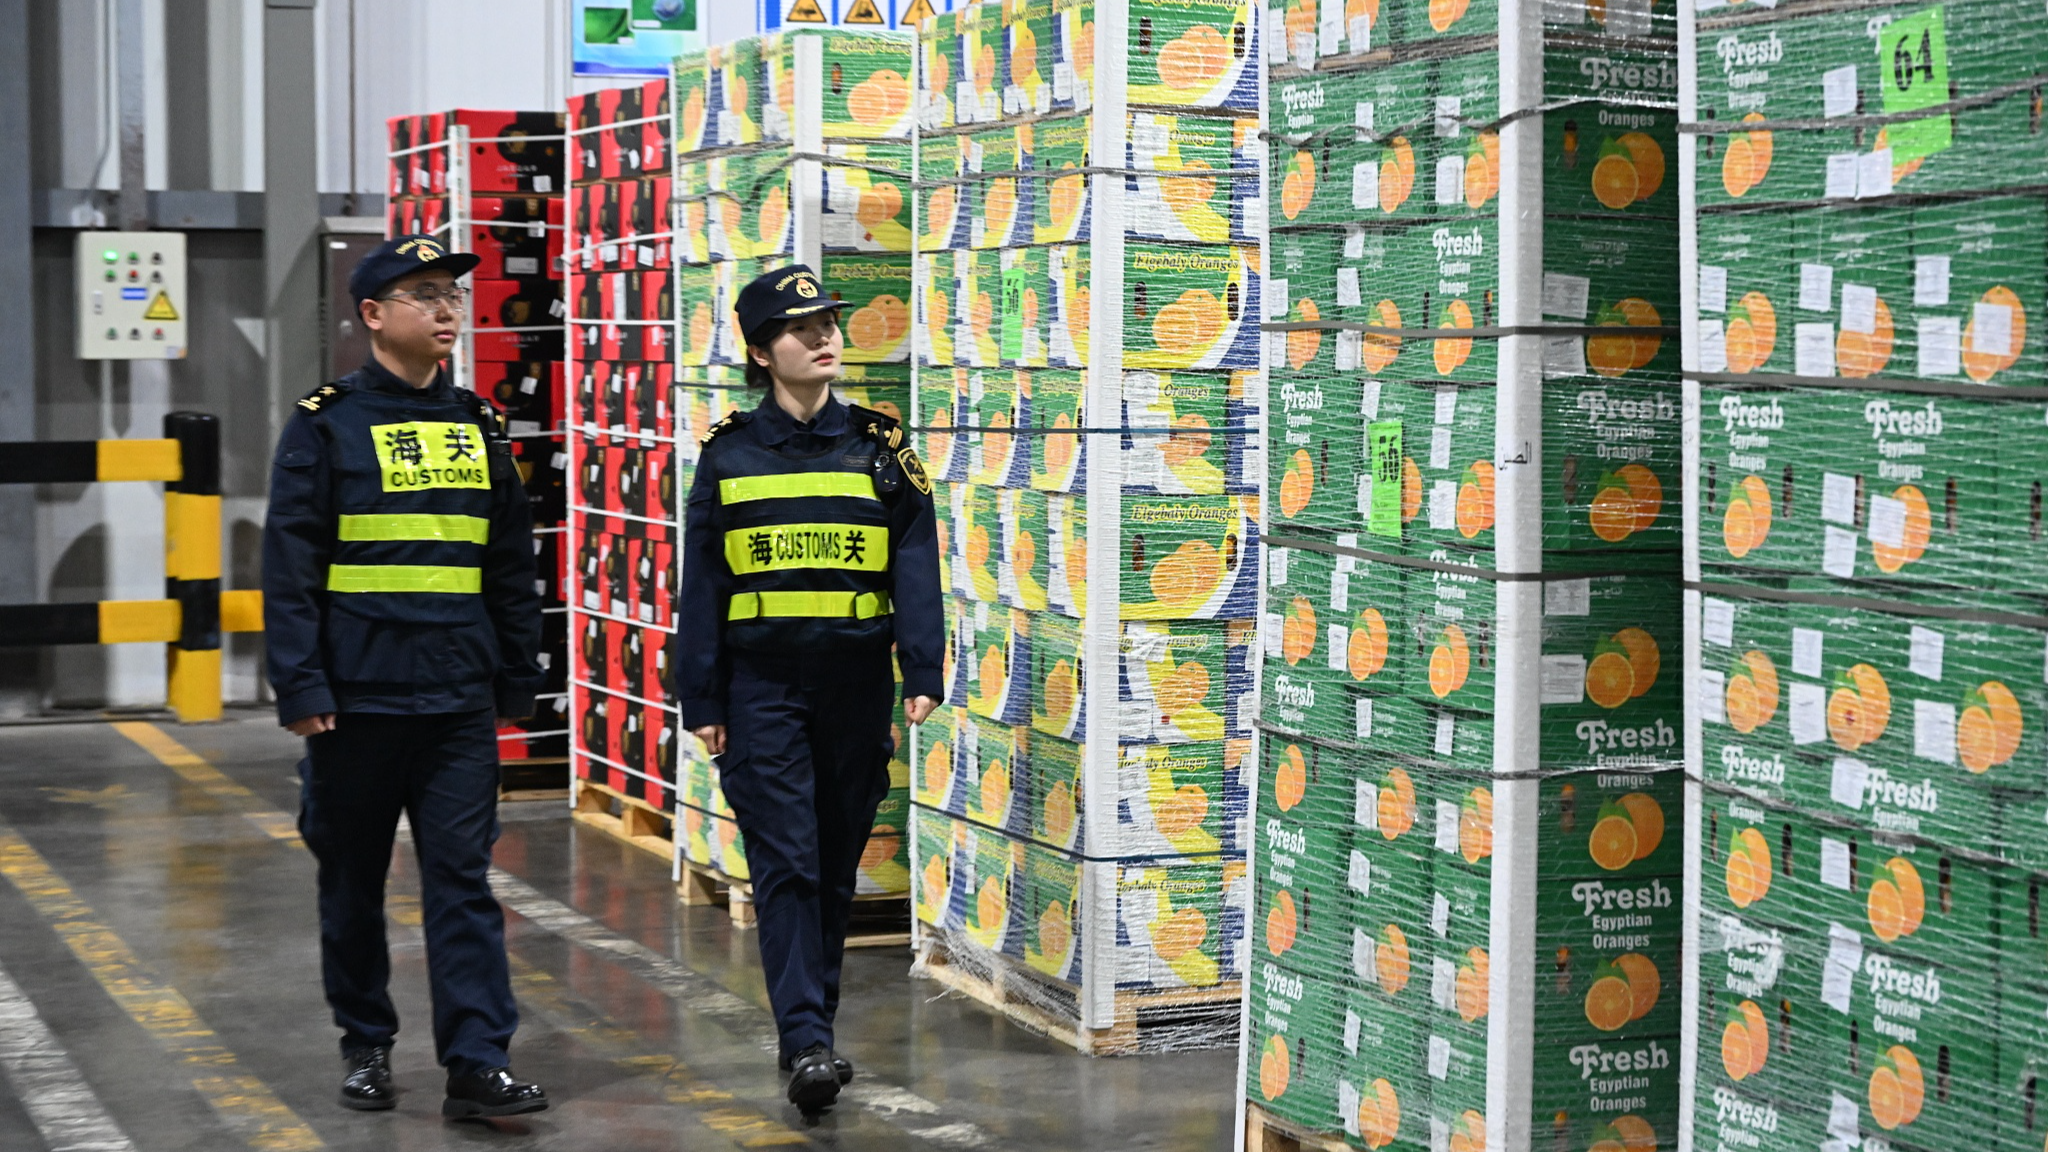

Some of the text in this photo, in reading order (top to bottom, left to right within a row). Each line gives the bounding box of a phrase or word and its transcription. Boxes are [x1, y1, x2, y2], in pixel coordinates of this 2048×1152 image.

[1717, 31, 1783, 73] Fresh
[1894, 28, 1934, 92] 64
[1580, 57, 1678, 90] Fresh
[1282, 81, 1325, 116] Fresh
[1599, 110, 1655, 129] Oranges
[1169, 130, 1215, 145] Oranges
[1432, 226, 1483, 262] Fresh
[1190, 254, 1239, 271] Oranges
[1439, 260, 1471, 277] Egyptian
[1439, 279, 1469, 297] Oranges
[1164, 384, 1209, 399] Oranges
[1281, 382, 1323, 413] Fresh
[1577, 391, 1675, 423] Fresh
[1719, 395, 1784, 432] Fresh
[1286, 413, 1313, 428] Egyptian
[1864, 400, 1942, 439] Fresh
[1286, 430, 1311, 446] Oranges
[1597, 423, 1655, 441] Egyptian
[1730, 431, 1769, 450] Egyptian
[386, 428, 477, 466] 海关
[1597, 444, 1654, 460] Oranges
[1878, 438, 1926, 458] Egyptian
[1728, 451, 1767, 473] Oranges
[1878, 460, 1923, 483] Oranges
[391, 468, 483, 487] CUSTOMS
[1189, 506, 1238, 522] Oranges
[748, 530, 865, 565] 海 CUSTOMS 关
[1275, 675, 1315, 707] Fresh
[1576, 718, 1676, 755] Fresh
[1162, 757, 1207, 770] Oranges
[1597, 752, 1656, 768] Egyptian
[1721, 745, 1785, 785] Fresh
[1597, 774, 1654, 789] Oranges
[1865, 768, 1938, 813] Fresh
[1729, 801, 1765, 825] Oranges
[1873, 806, 1919, 831] Egyptian
[1266, 819, 1306, 855] Fresh
[1271, 850, 1296, 869] Egyptian
[1270, 866, 1293, 887] Oranges
[1571, 879, 1672, 916] Fresh
[1592, 914, 1652, 931] Egyptian
[1592, 934, 1650, 950] Oranges
[1263, 962, 1304, 1002] Fresh
[1726, 972, 1763, 998] Oranges
[1865, 953, 1940, 1004] Fresh
[1267, 994, 1292, 1014] Egyptian
[1875, 993, 1921, 1020] Egyptian
[1265, 1010, 1288, 1033] Oranges
[1873, 1014, 1917, 1043] Oranges
[1569, 1041, 1670, 1080] Fresh
[1590, 1076, 1649, 1093] Egyptian
[1590, 1096, 1646, 1112] Oranges
[1713, 1086, 1778, 1134] Fresh
[1719, 1122, 1760, 1148] Egyptian
